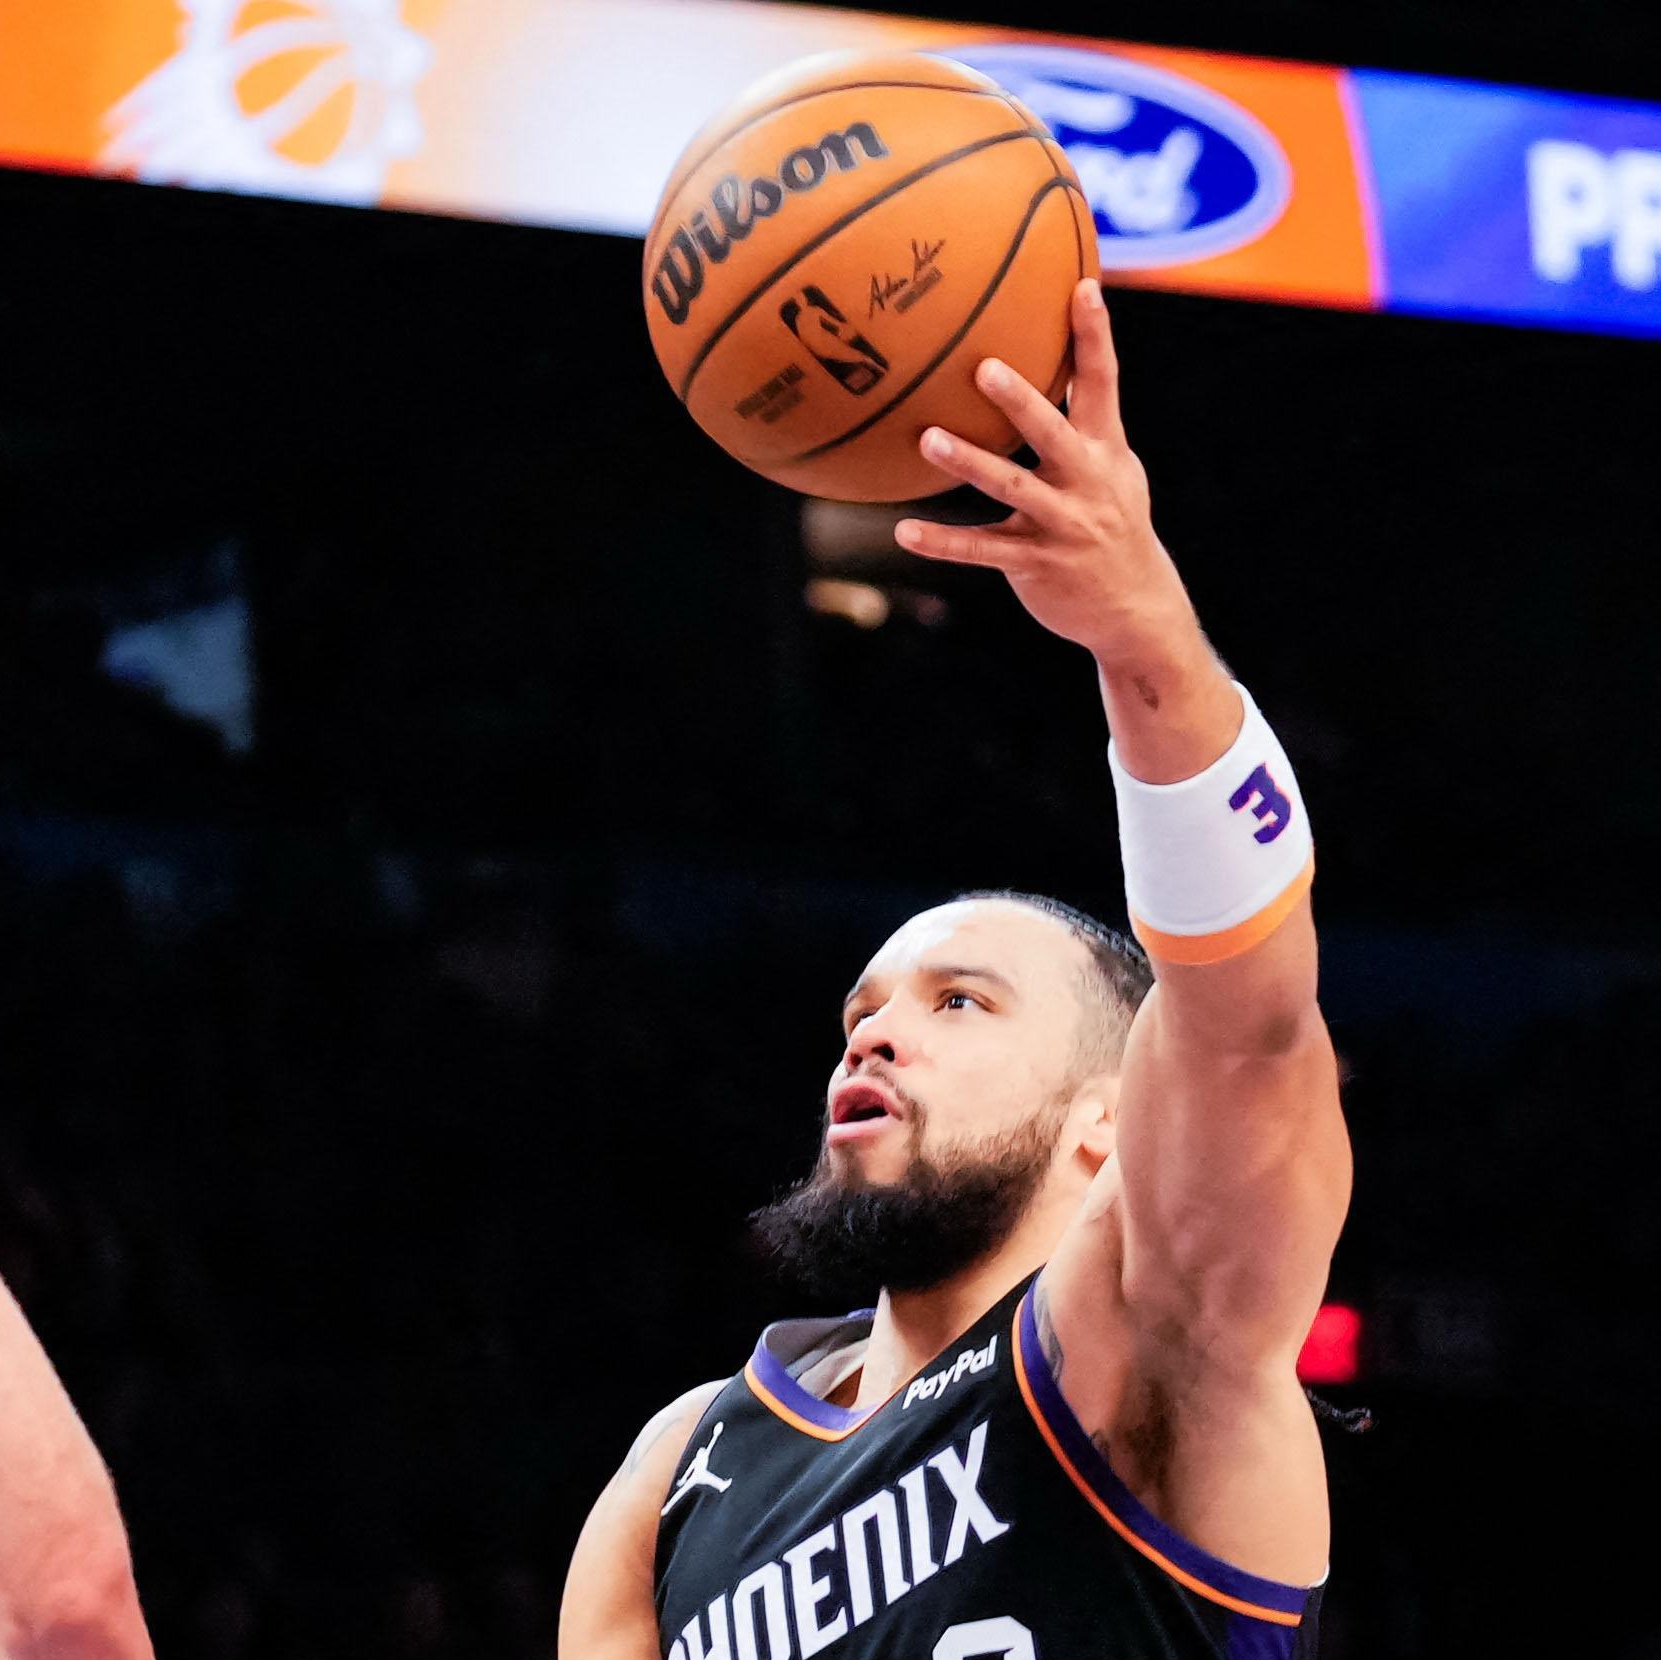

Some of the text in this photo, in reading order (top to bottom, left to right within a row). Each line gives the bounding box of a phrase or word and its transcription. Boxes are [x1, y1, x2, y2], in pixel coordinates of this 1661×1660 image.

[652, 121, 890, 325] Wilson
[1229, 762, 1291, 844] 3
[902, 1334, 998, 1410] PayPal
